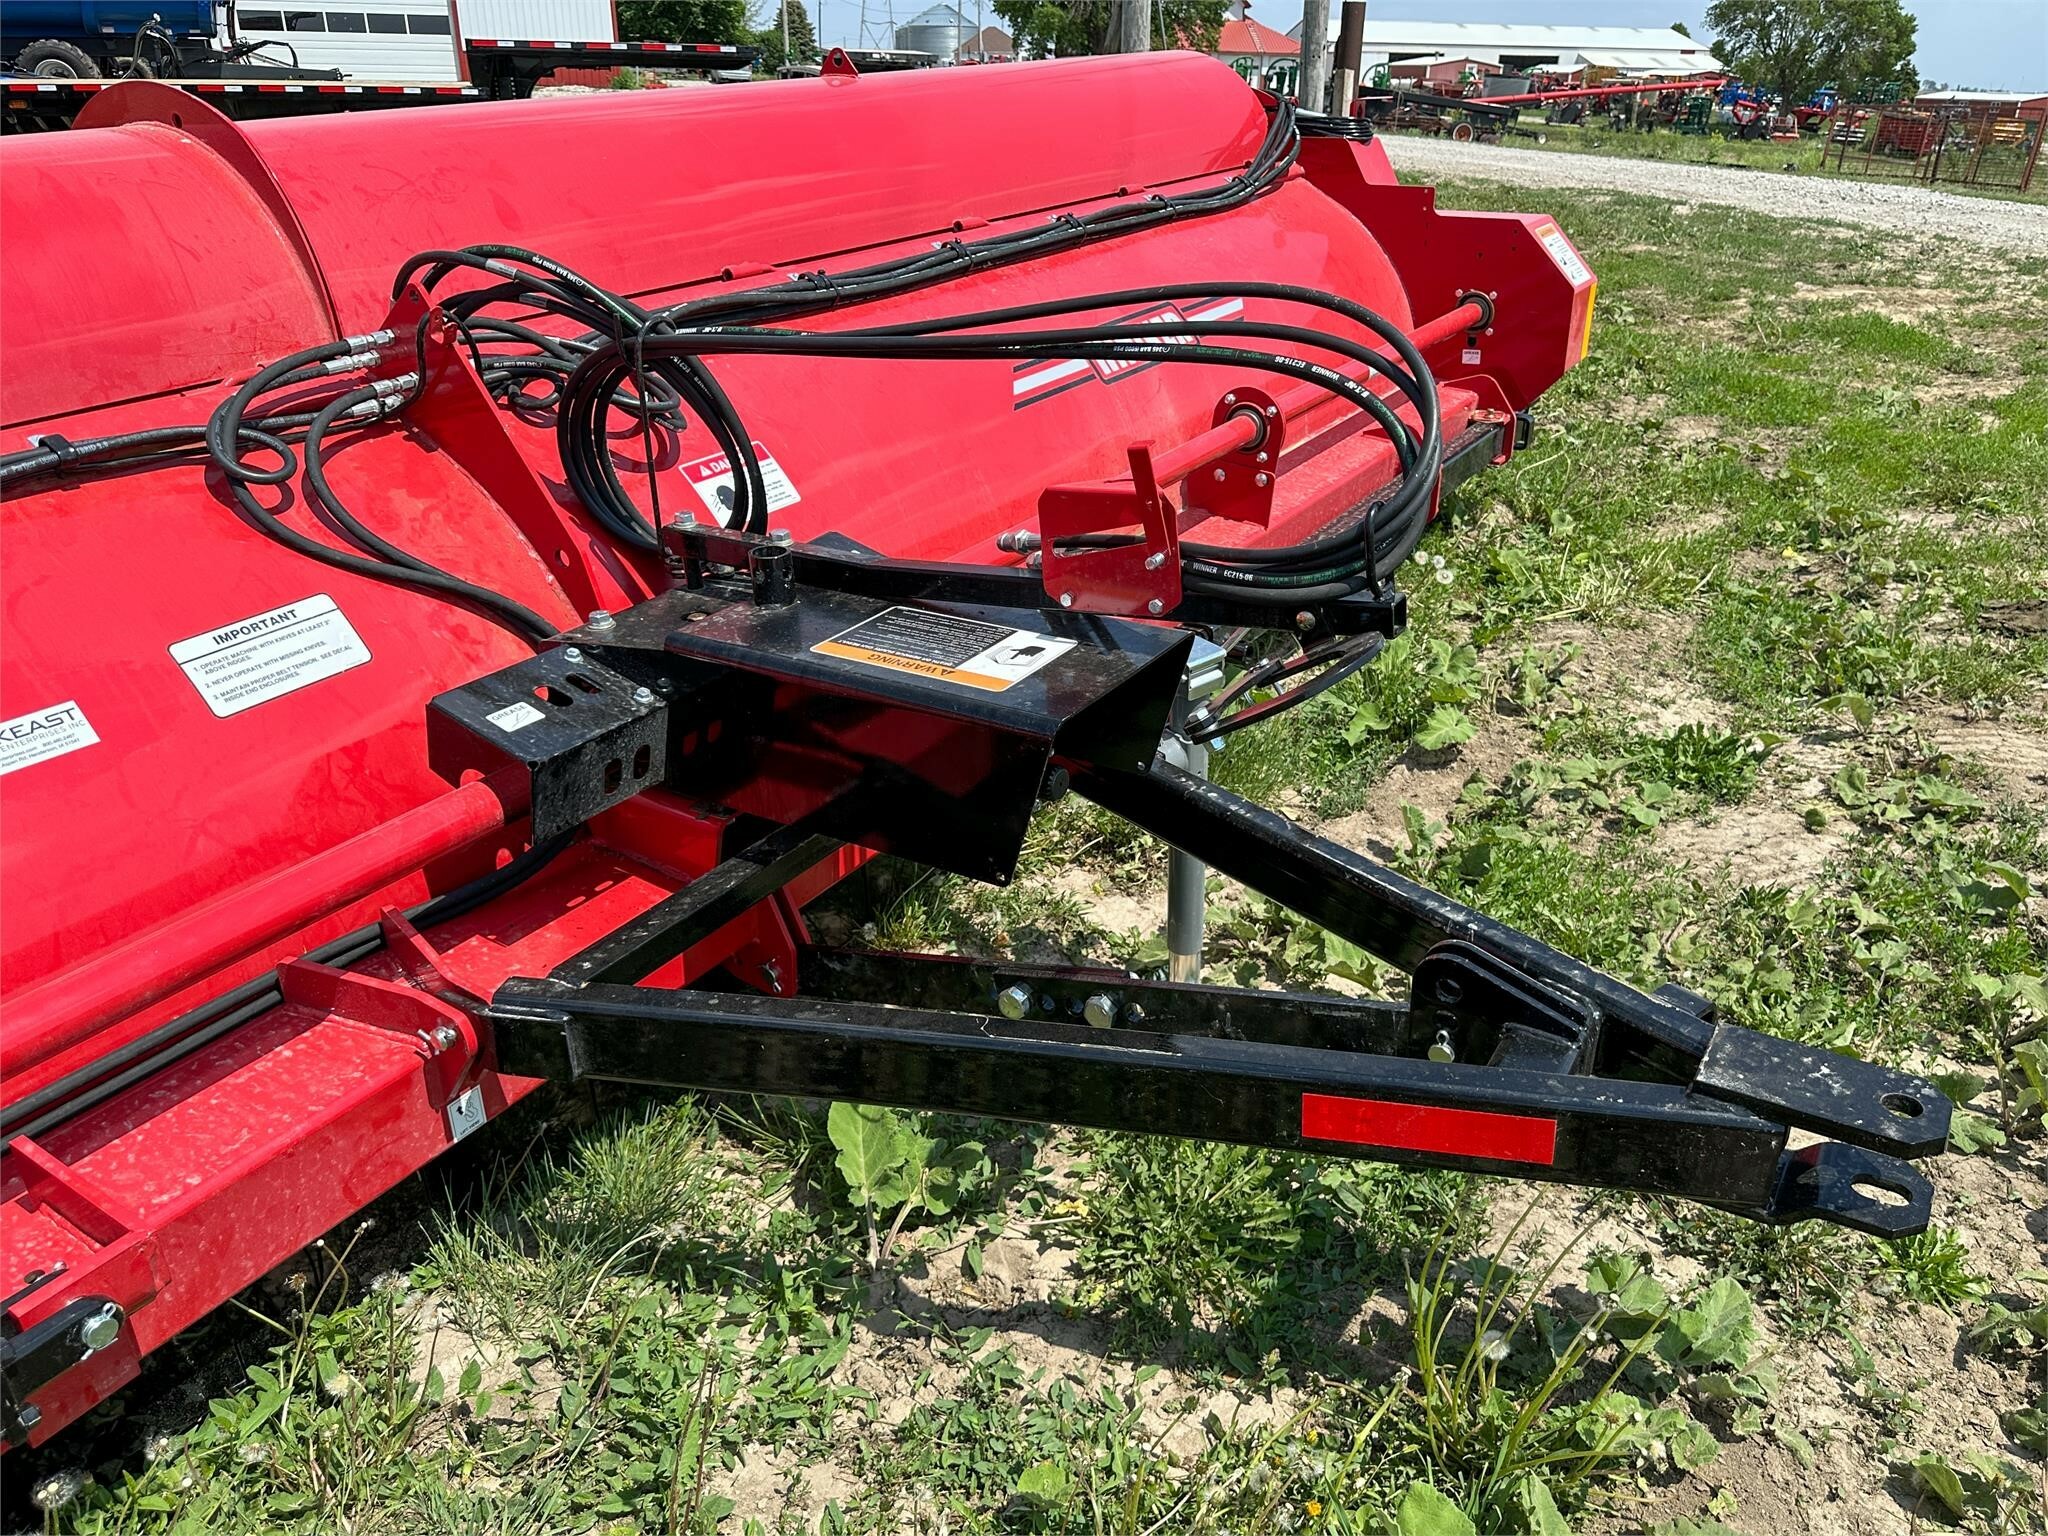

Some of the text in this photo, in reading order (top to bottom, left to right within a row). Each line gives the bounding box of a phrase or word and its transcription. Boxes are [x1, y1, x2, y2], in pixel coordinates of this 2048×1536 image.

[1274, 356, 1306, 368] EC215-06
[1311, 365, 1340, 381] WINNER
[1193, 562, 1218, 574] WINNER
[1223, 569, 1254, 581] EC215-06
[212, 609, 297, 645] IMPORTANT
[200, 655, 231, 669] OPERATE
[230, 645, 258, 659] MACHINE
[259, 639, 275, 649] WITH
[275, 631, 297, 643] KNIVES
[297, 628, 305, 636] AT
[305, 621, 324, 633] LEAST
[204, 664, 227, 675] ABOVE
[211, 674, 234, 686] NEVER
[233, 664, 263, 678] OPERATE
[262, 658, 280, 667] WITH
[278, 648, 304, 661] MISSING
[867, 653, 938, 674] WARNING
[220, 682, 250, 697] MAINTAIN
[250, 673, 276, 686] PROPER
[275, 665, 291, 675] BELT
[320, 651, 333, 660] SEE
[223, 691, 245, 703] INSIDE
[245, 686, 259, 695] END
[491, 704, 528, 721] GREASE
[0, 719, 86, 752] ENTERPRISES INC
